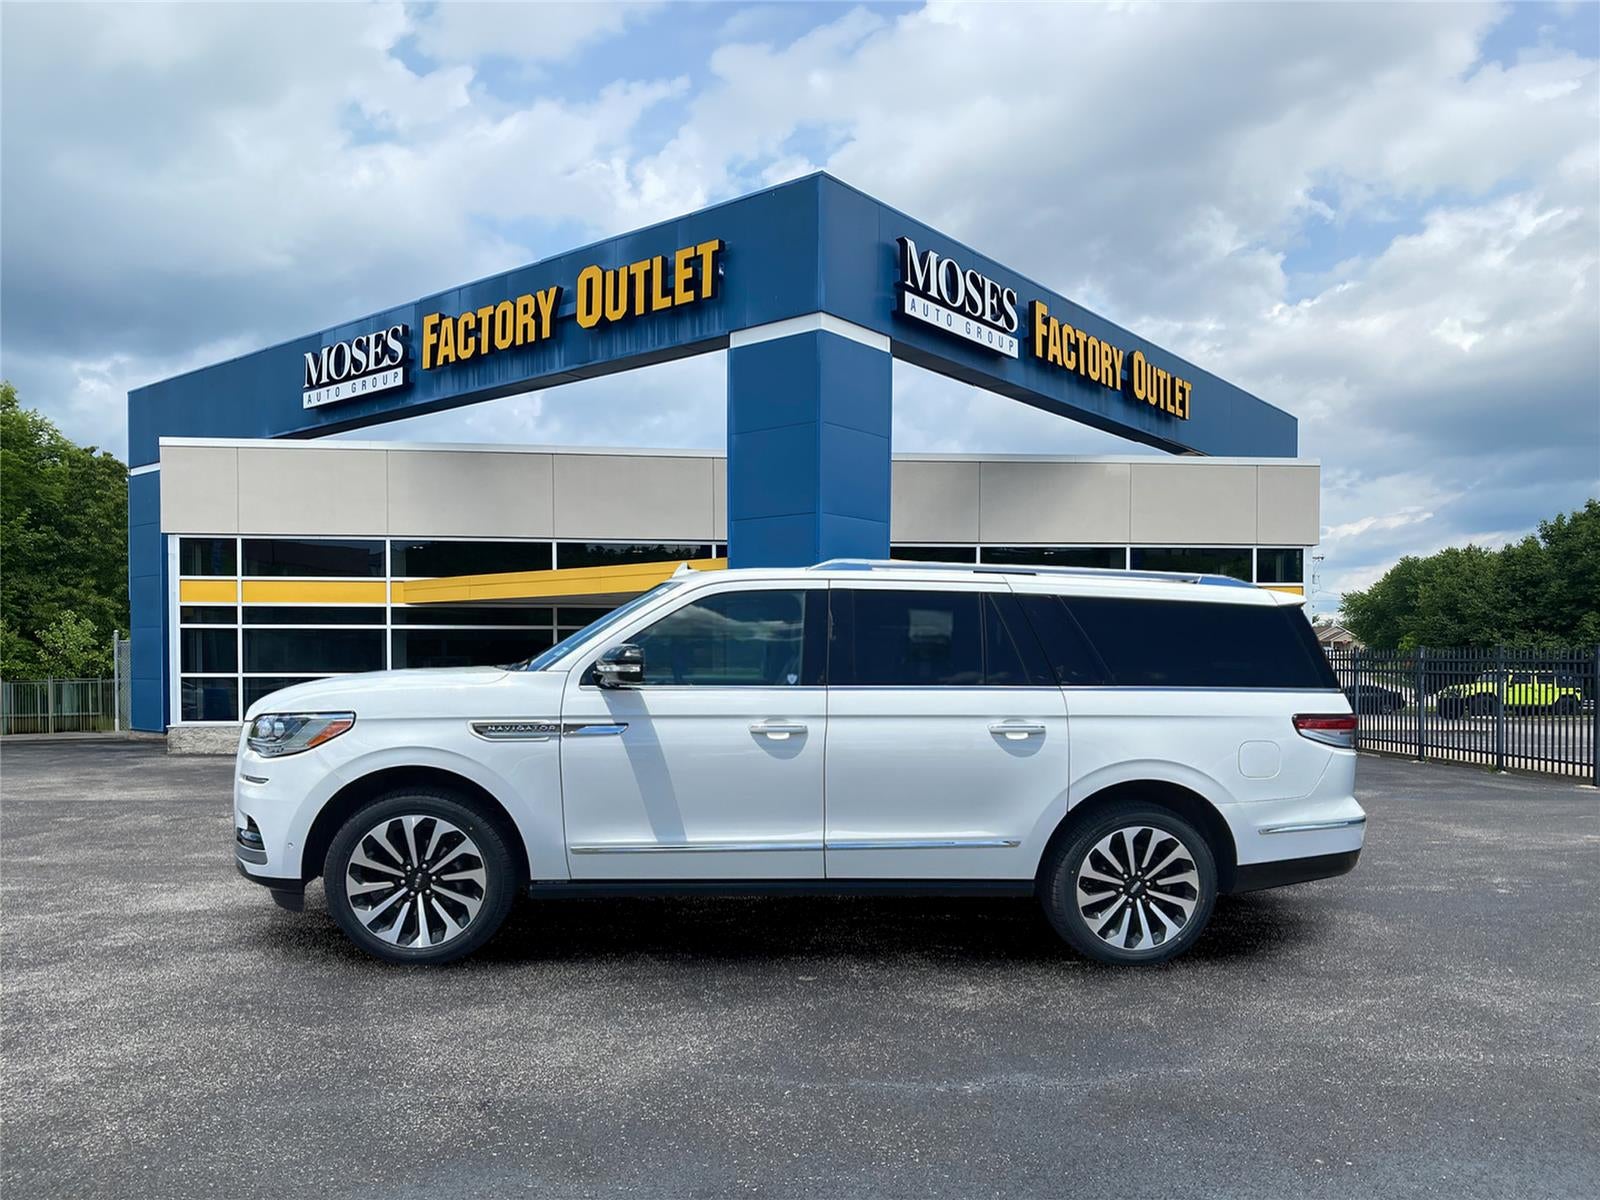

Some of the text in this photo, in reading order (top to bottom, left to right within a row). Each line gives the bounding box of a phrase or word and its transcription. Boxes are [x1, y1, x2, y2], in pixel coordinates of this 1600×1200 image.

[422, 239, 720, 370] FACTORY OUTLET
[904, 237, 1018, 333] MOSES
[910, 298, 1014, 352] AUTO GROUP
[303, 324, 404, 388] MOSES
[307, 371, 399, 405] AUTO GROUP
[1035, 300, 1192, 420] FACTORY OUTLET
